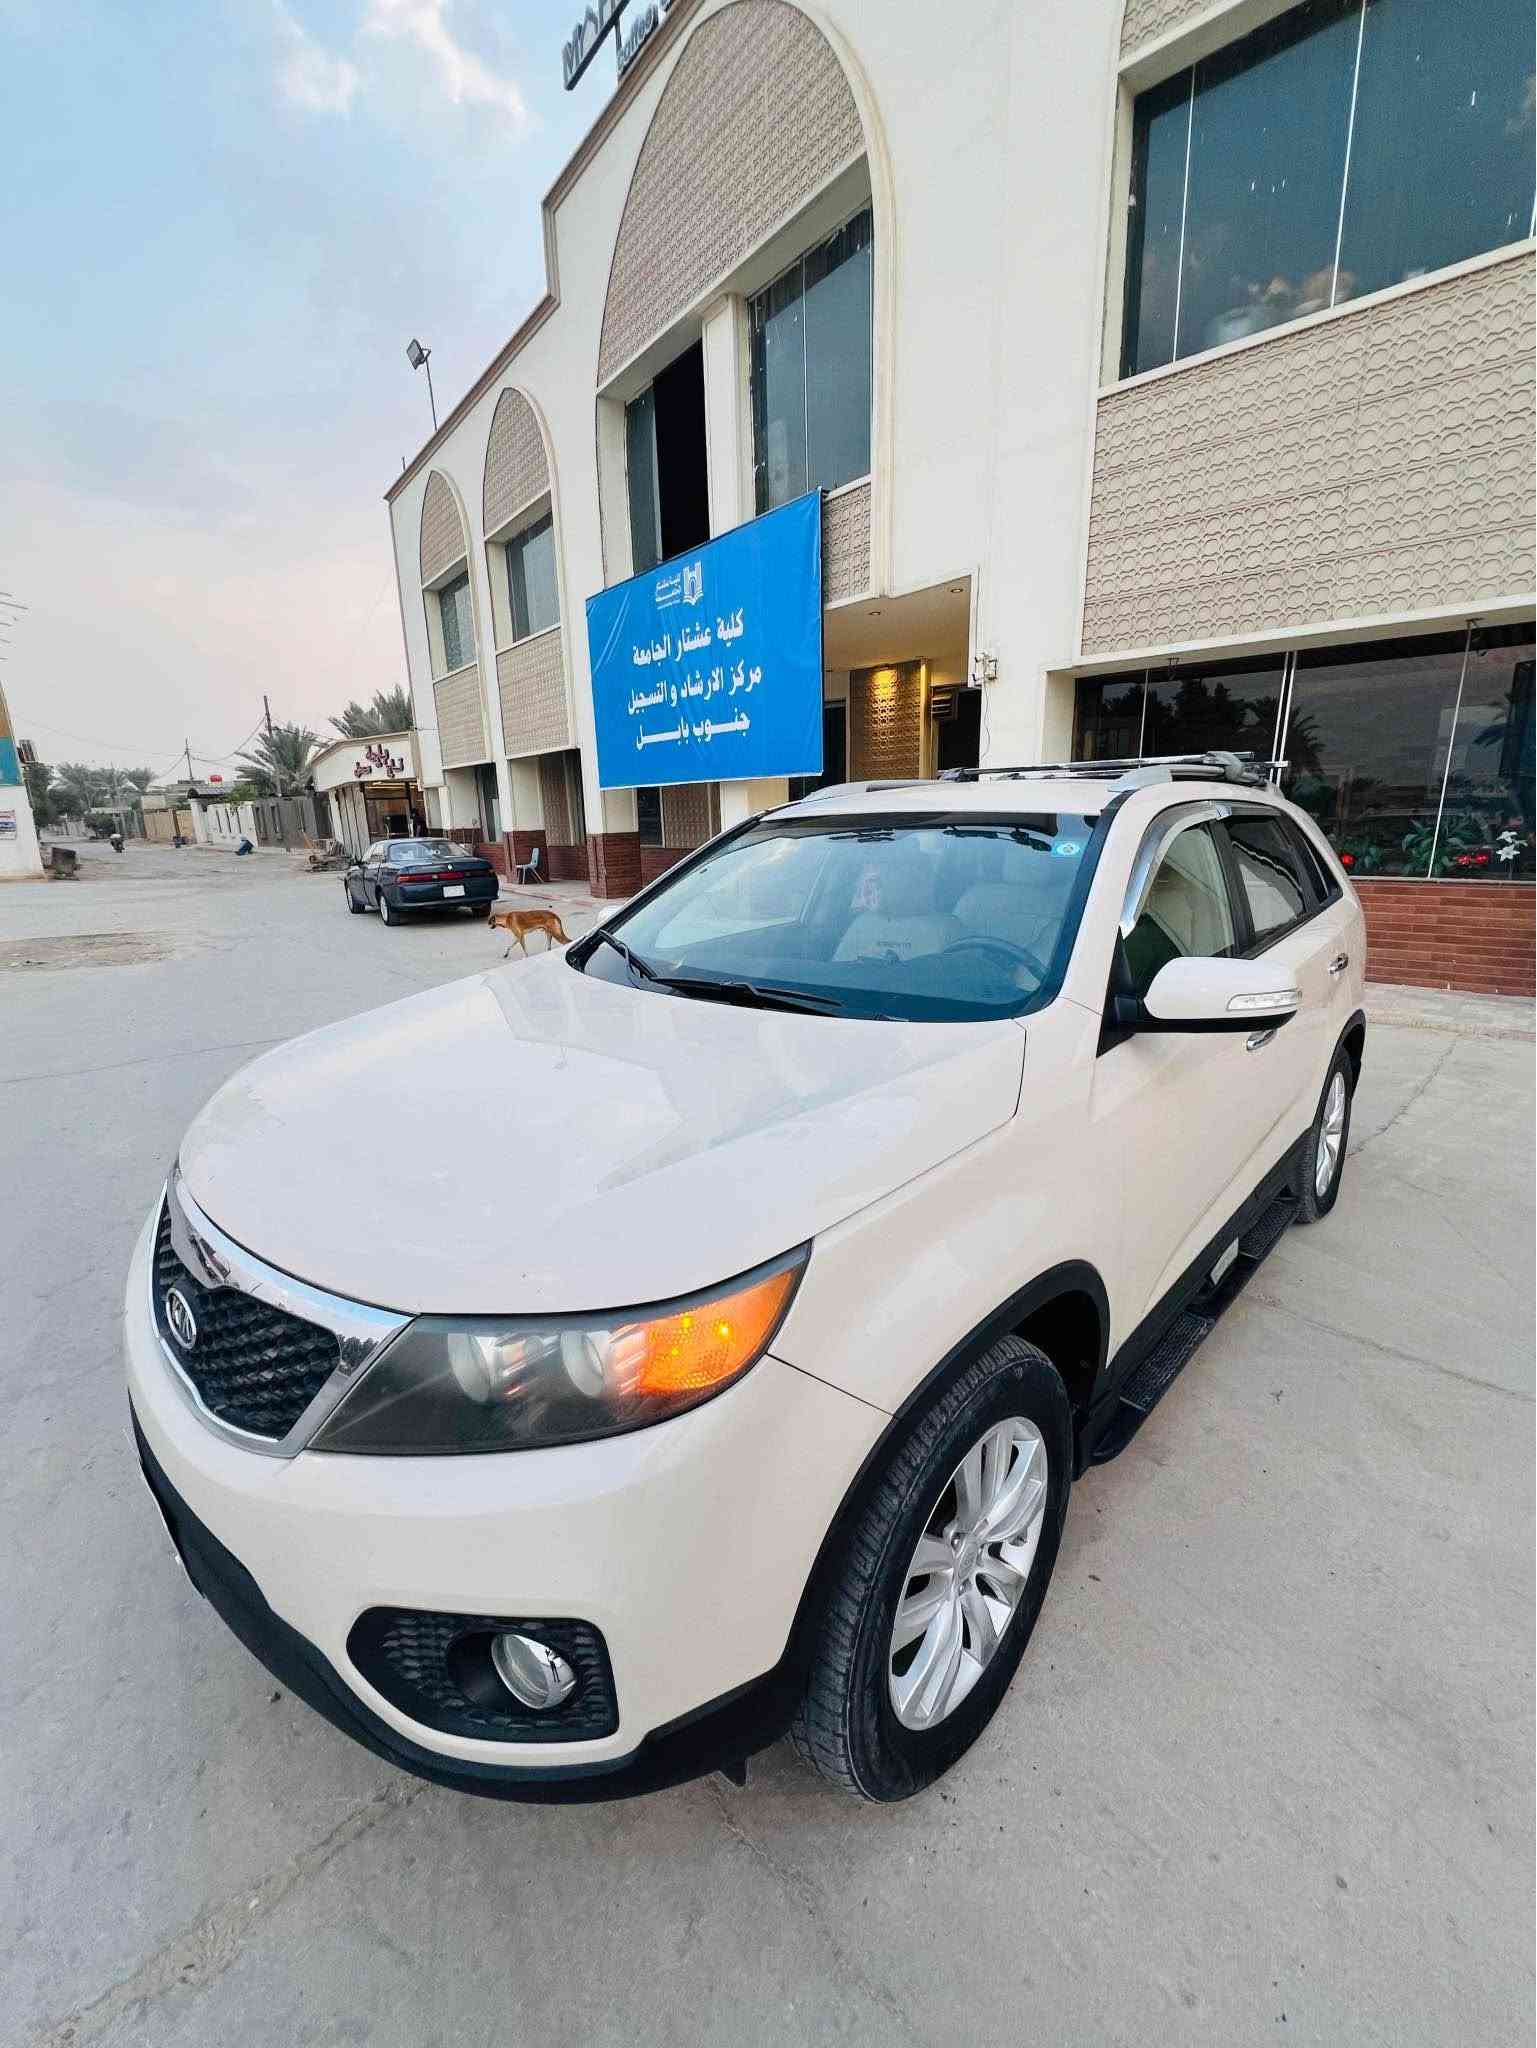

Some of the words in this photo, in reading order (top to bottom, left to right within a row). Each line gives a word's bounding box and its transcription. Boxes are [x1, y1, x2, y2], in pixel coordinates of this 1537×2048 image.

[675, 621, 712, 662] عشتار
[716, 607, 744, 648] كلية
[632, 632, 672, 667] الجامعة
[728, 658, 762, 696] مركز
